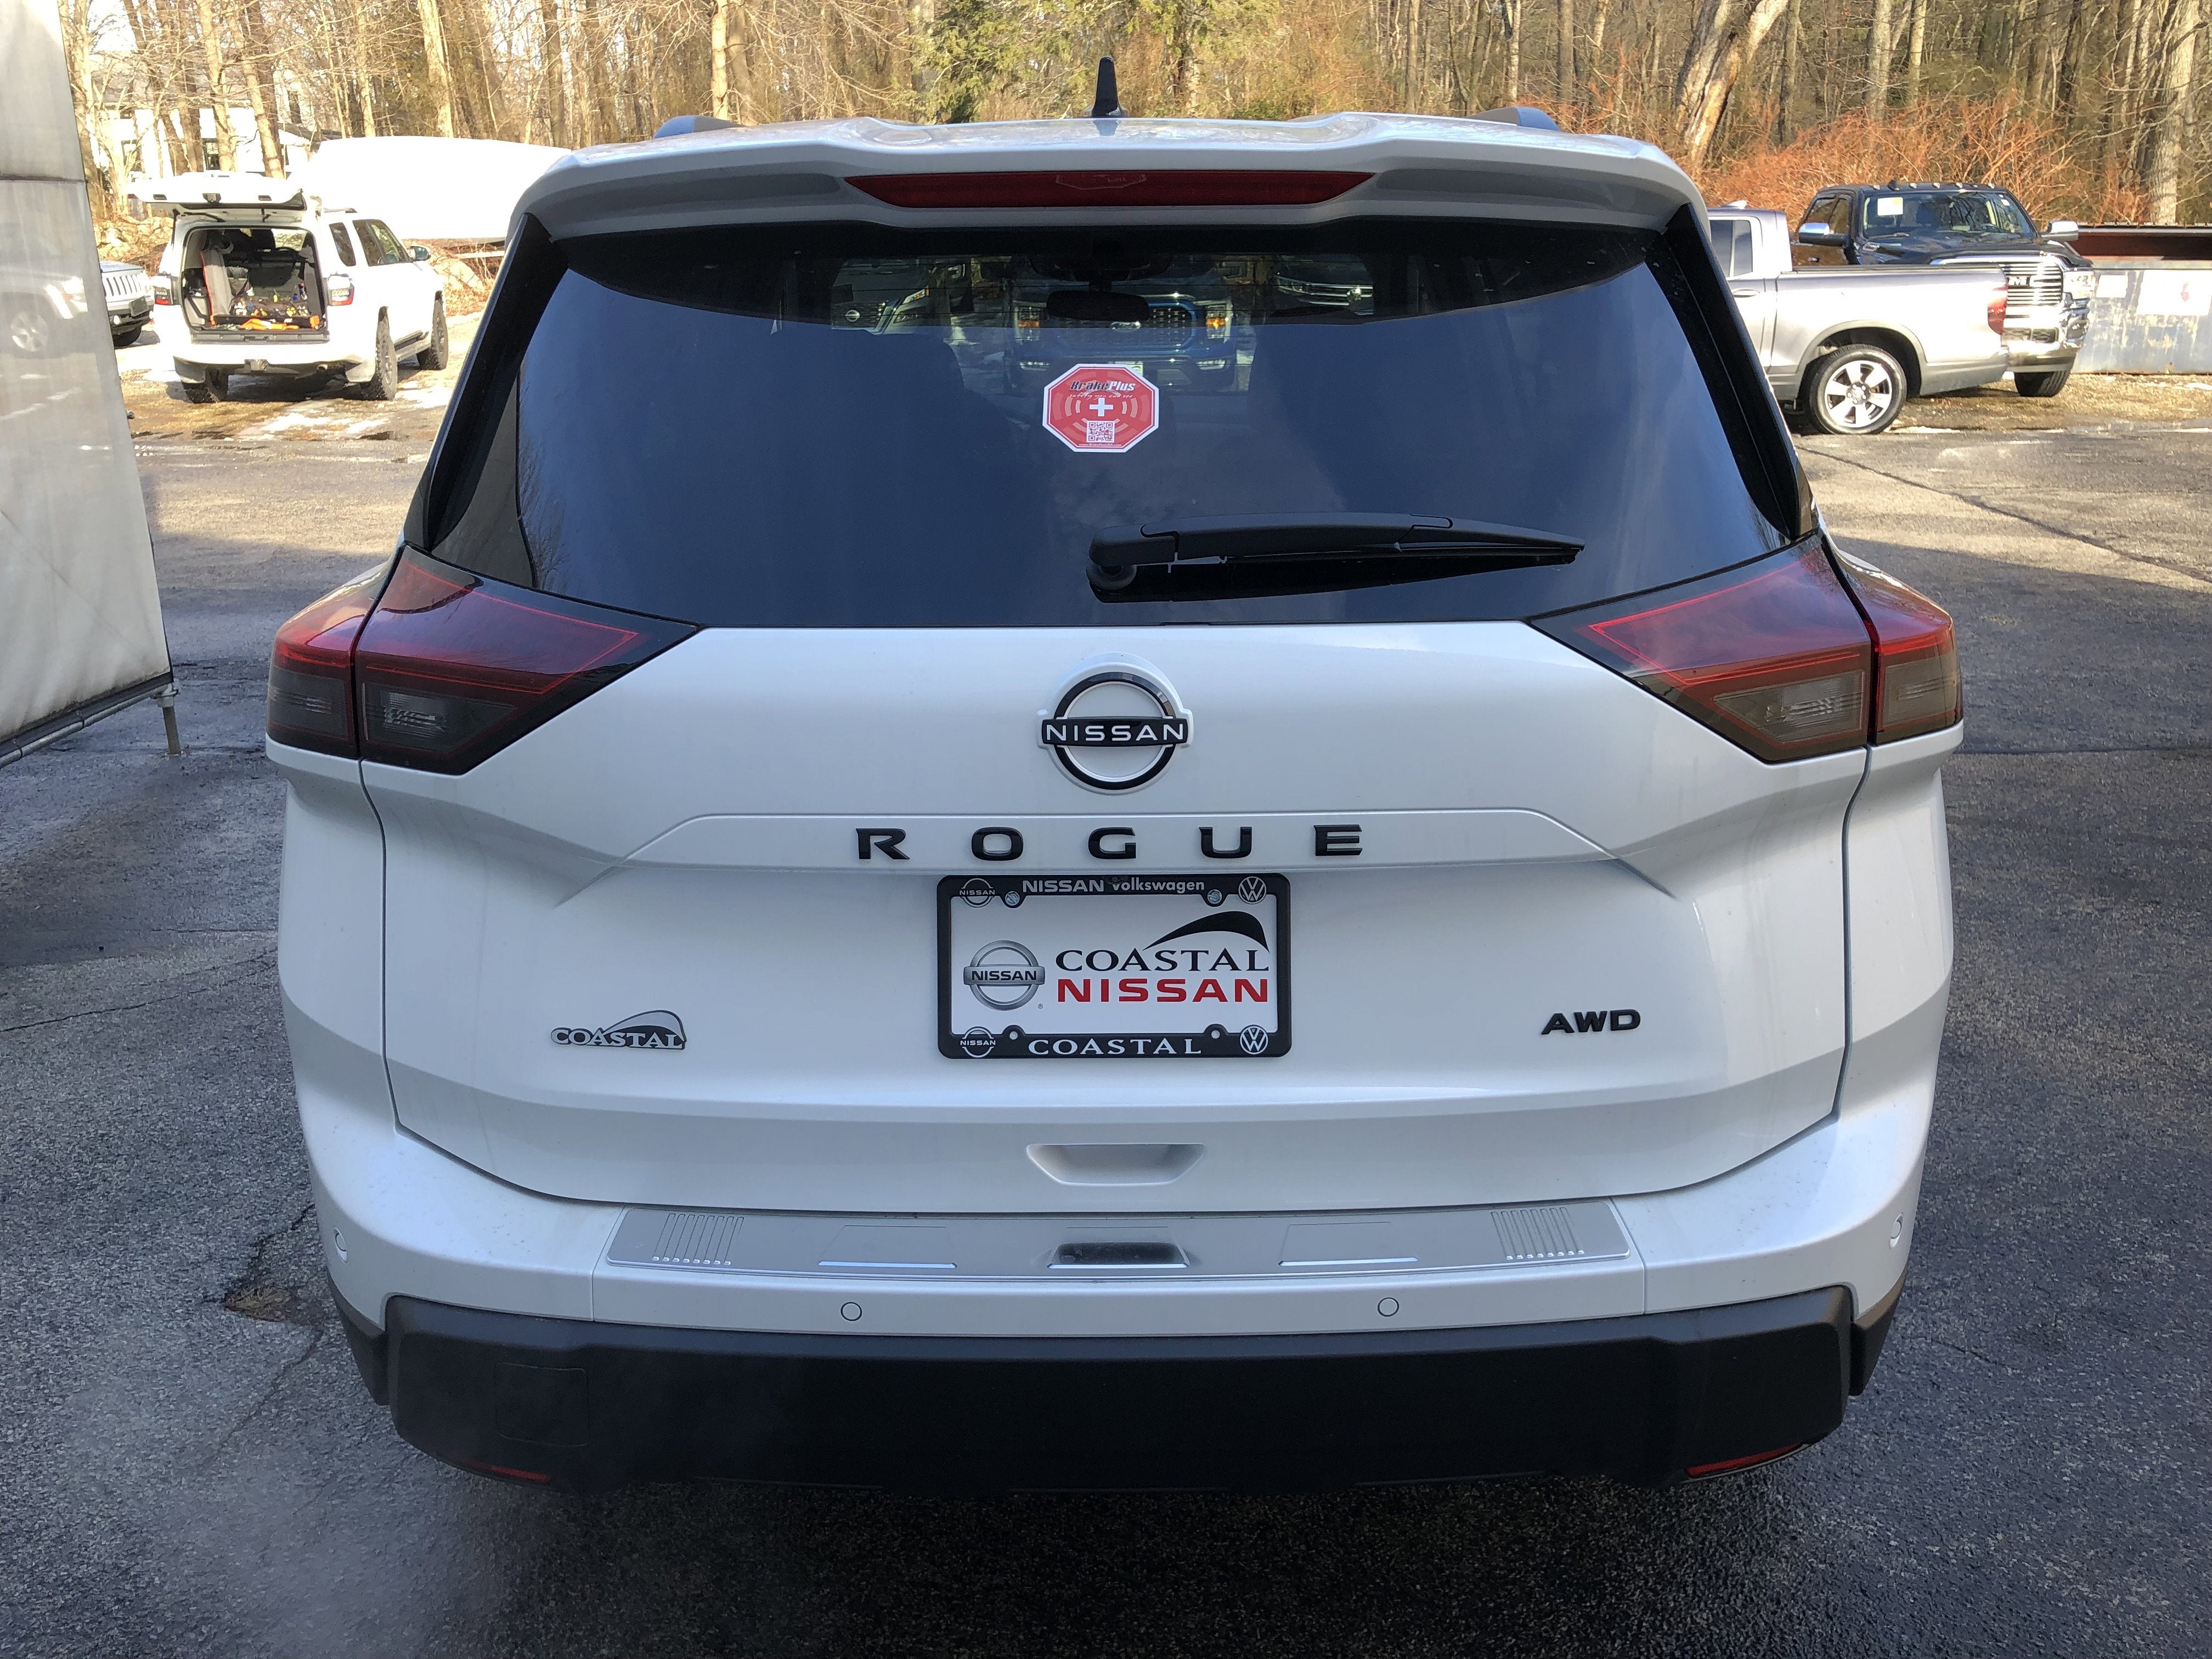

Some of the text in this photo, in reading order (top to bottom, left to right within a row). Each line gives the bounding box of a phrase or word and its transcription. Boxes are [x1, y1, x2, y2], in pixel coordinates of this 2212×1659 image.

[1069, 392, 1093, 400] safety
[1046, 723, 1183, 742] NISSAN
[855, 825, 1363, 861] ROGUE
[1023, 877, 1204, 894] NISSAN volkswagen
[1055, 949, 1269, 972] COASTAL
[971, 969, 1037, 981] NISSAN
[1057, 978, 1268, 1003] NISSAN
[1541, 1009, 1641, 1035] AWD
[551, 1028, 685, 1049] COASTAL
[1028, 1037, 1201, 1055] COASTAL
